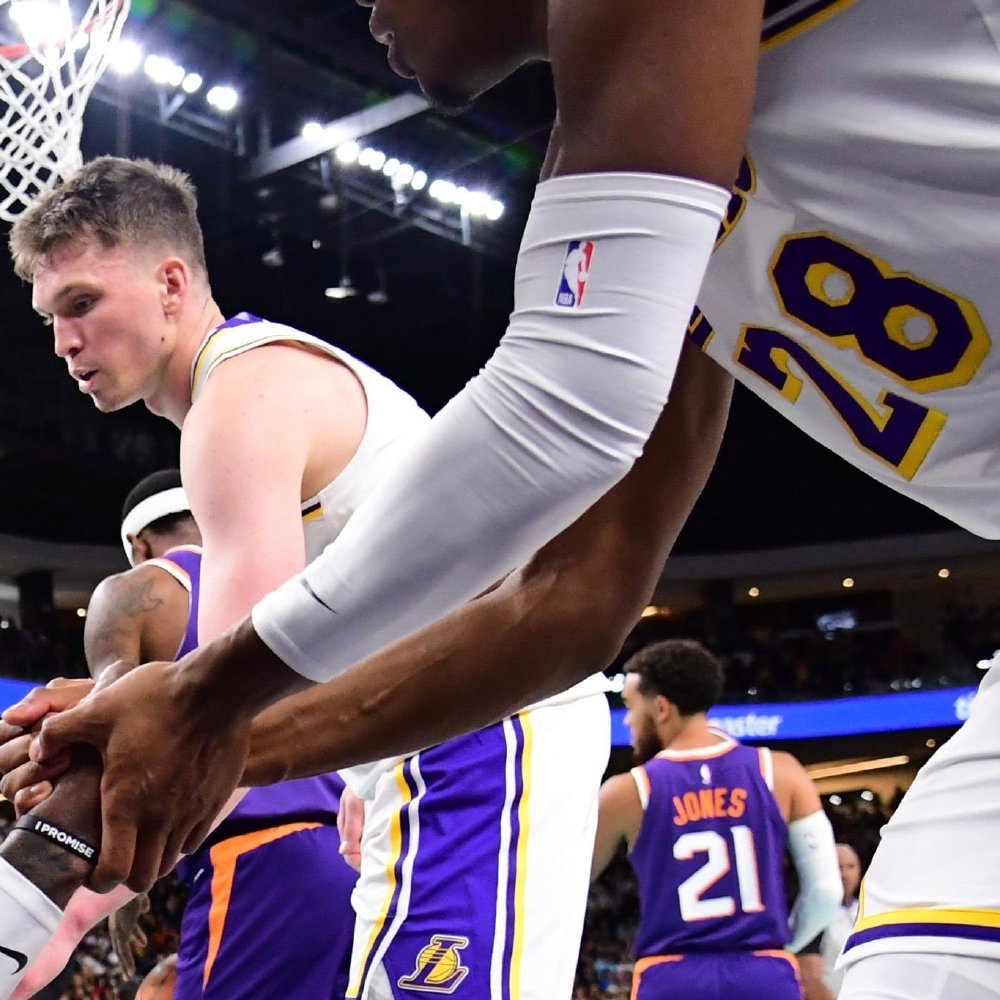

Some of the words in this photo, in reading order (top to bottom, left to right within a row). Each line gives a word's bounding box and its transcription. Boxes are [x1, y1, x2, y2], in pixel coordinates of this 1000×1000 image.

[733, 231, 991, 481] 28
[34, 821, 42, 830] I
[41, 823, 94, 858] PROMISE
[672, 787, 748, 826] JONES
[673, 825, 765, 922] 21
